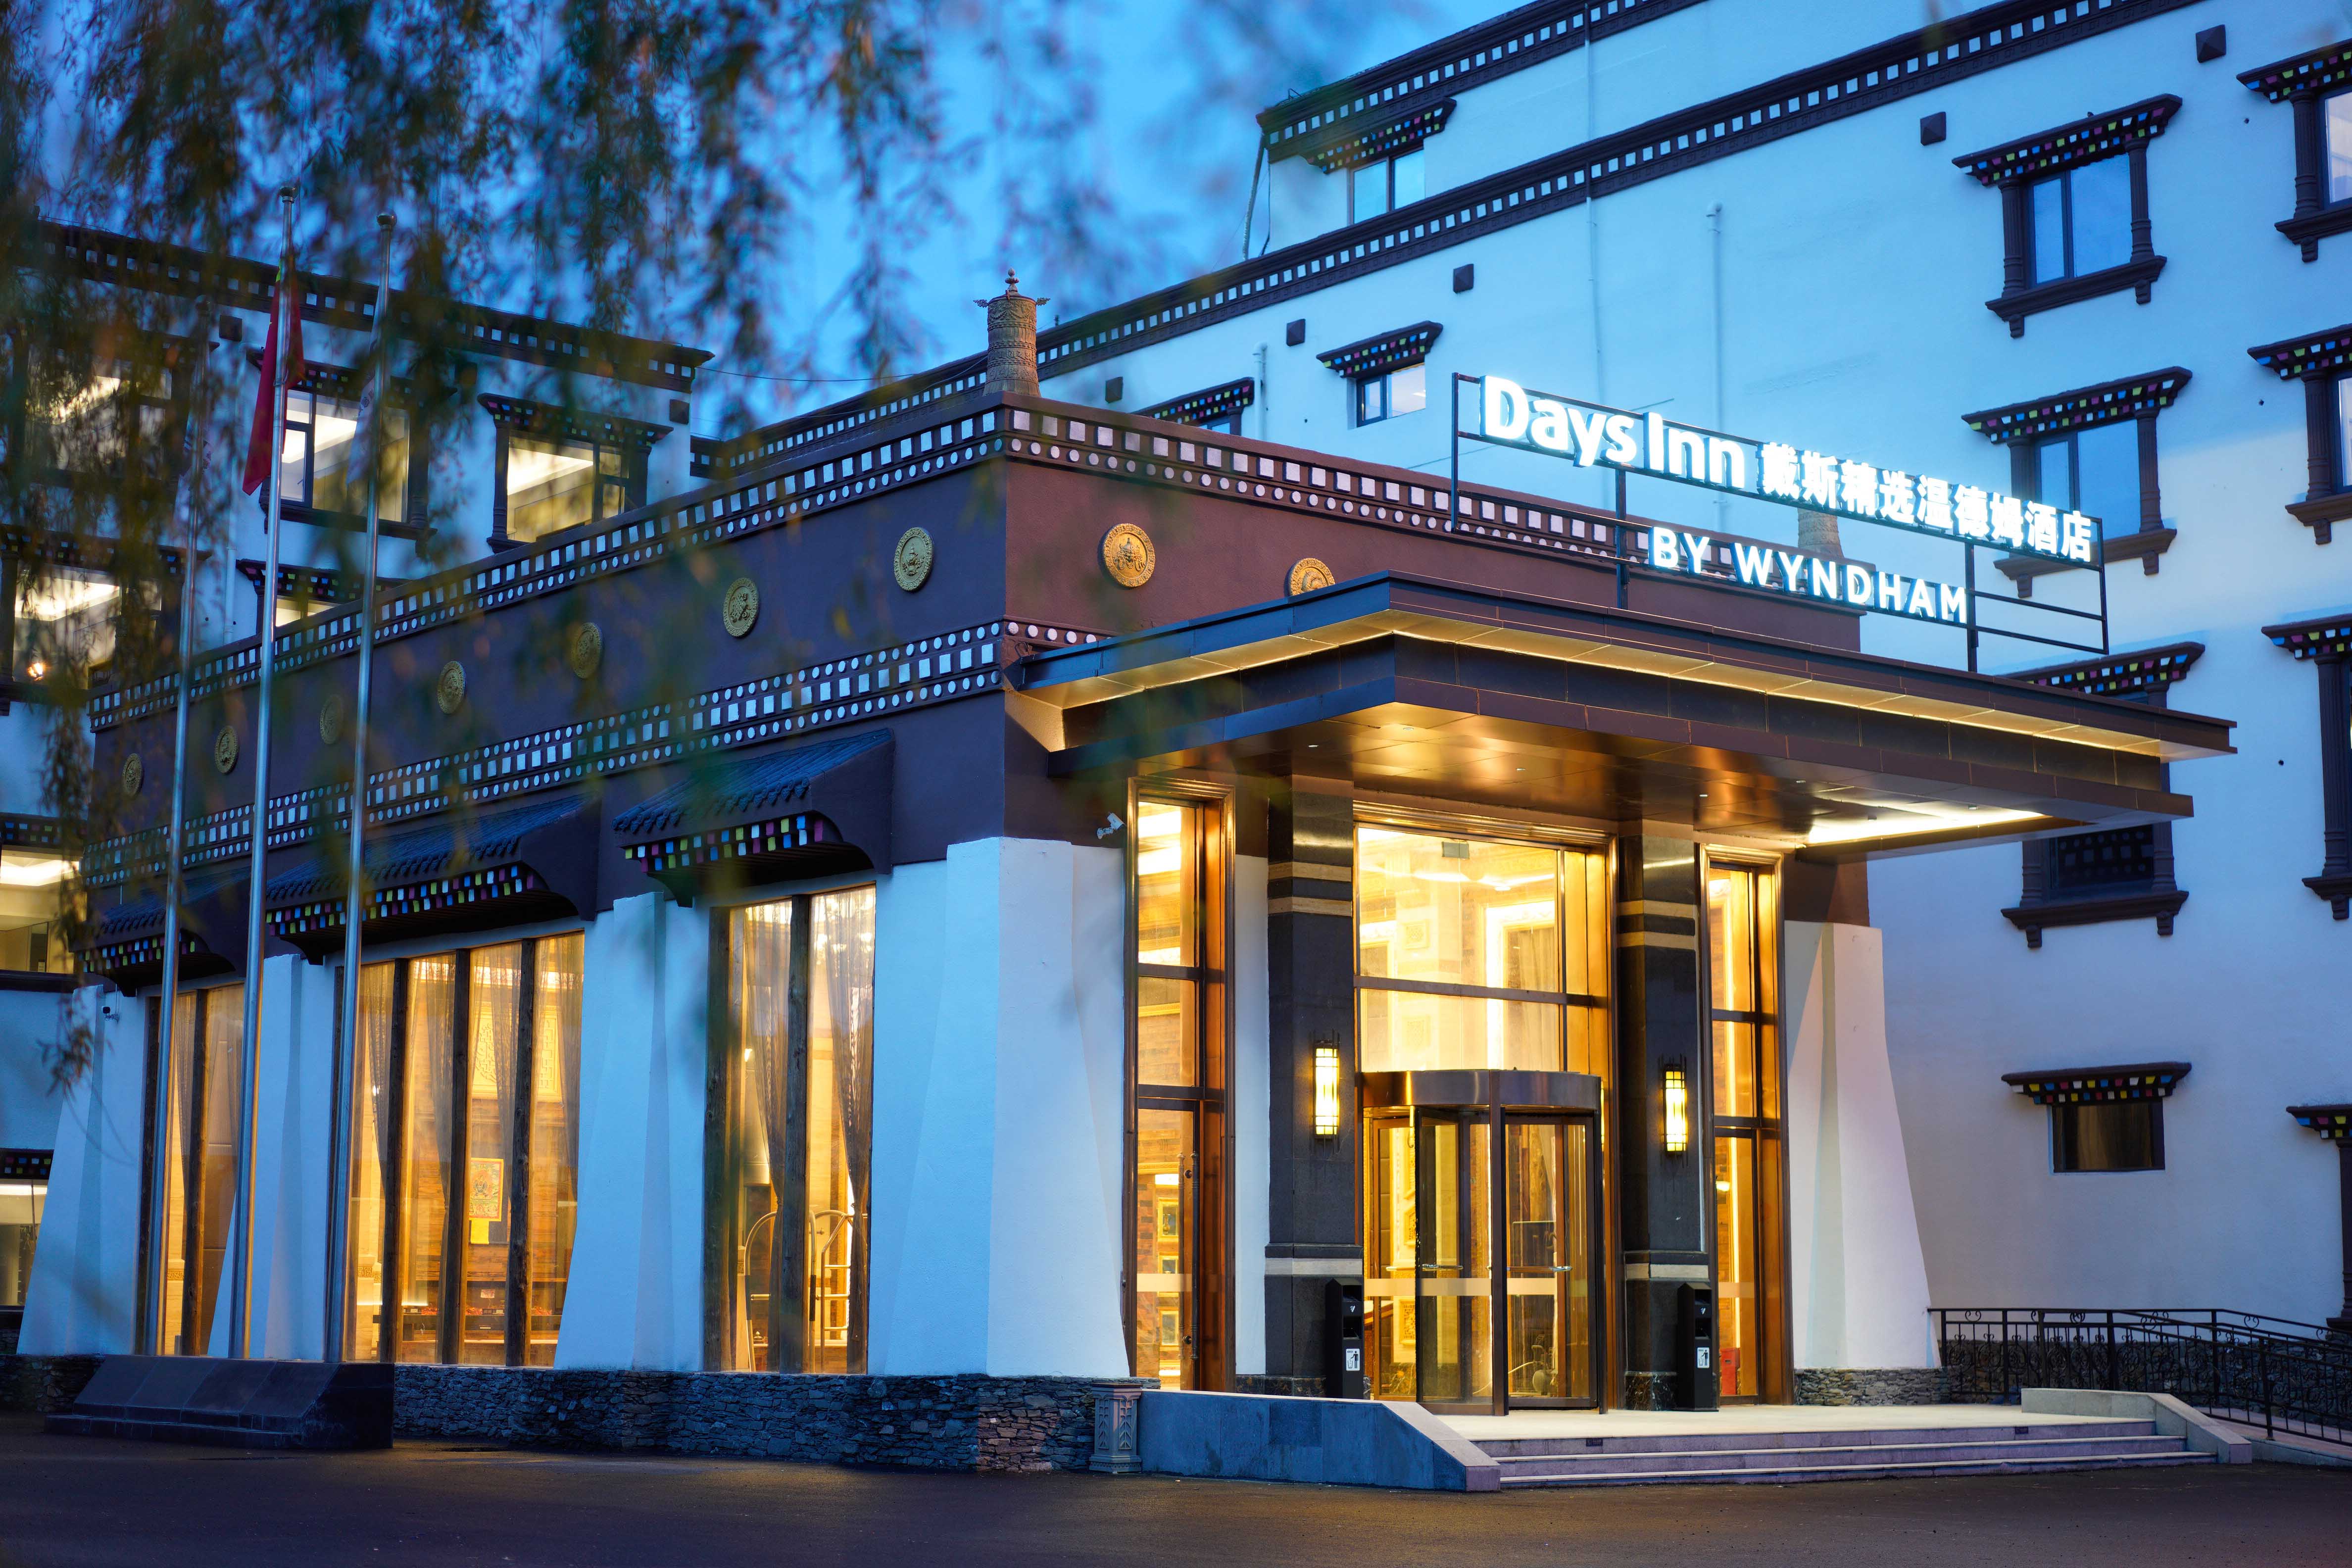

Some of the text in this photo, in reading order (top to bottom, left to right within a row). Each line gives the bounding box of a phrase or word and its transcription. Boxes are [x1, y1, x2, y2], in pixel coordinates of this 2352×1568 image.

[1480, 375, 1745, 490] Days Inn
[1757, 442, 2091, 562] 戴斯精选温德姆酒店
[1649, 526, 1967, 624] BY WYNDHAM
